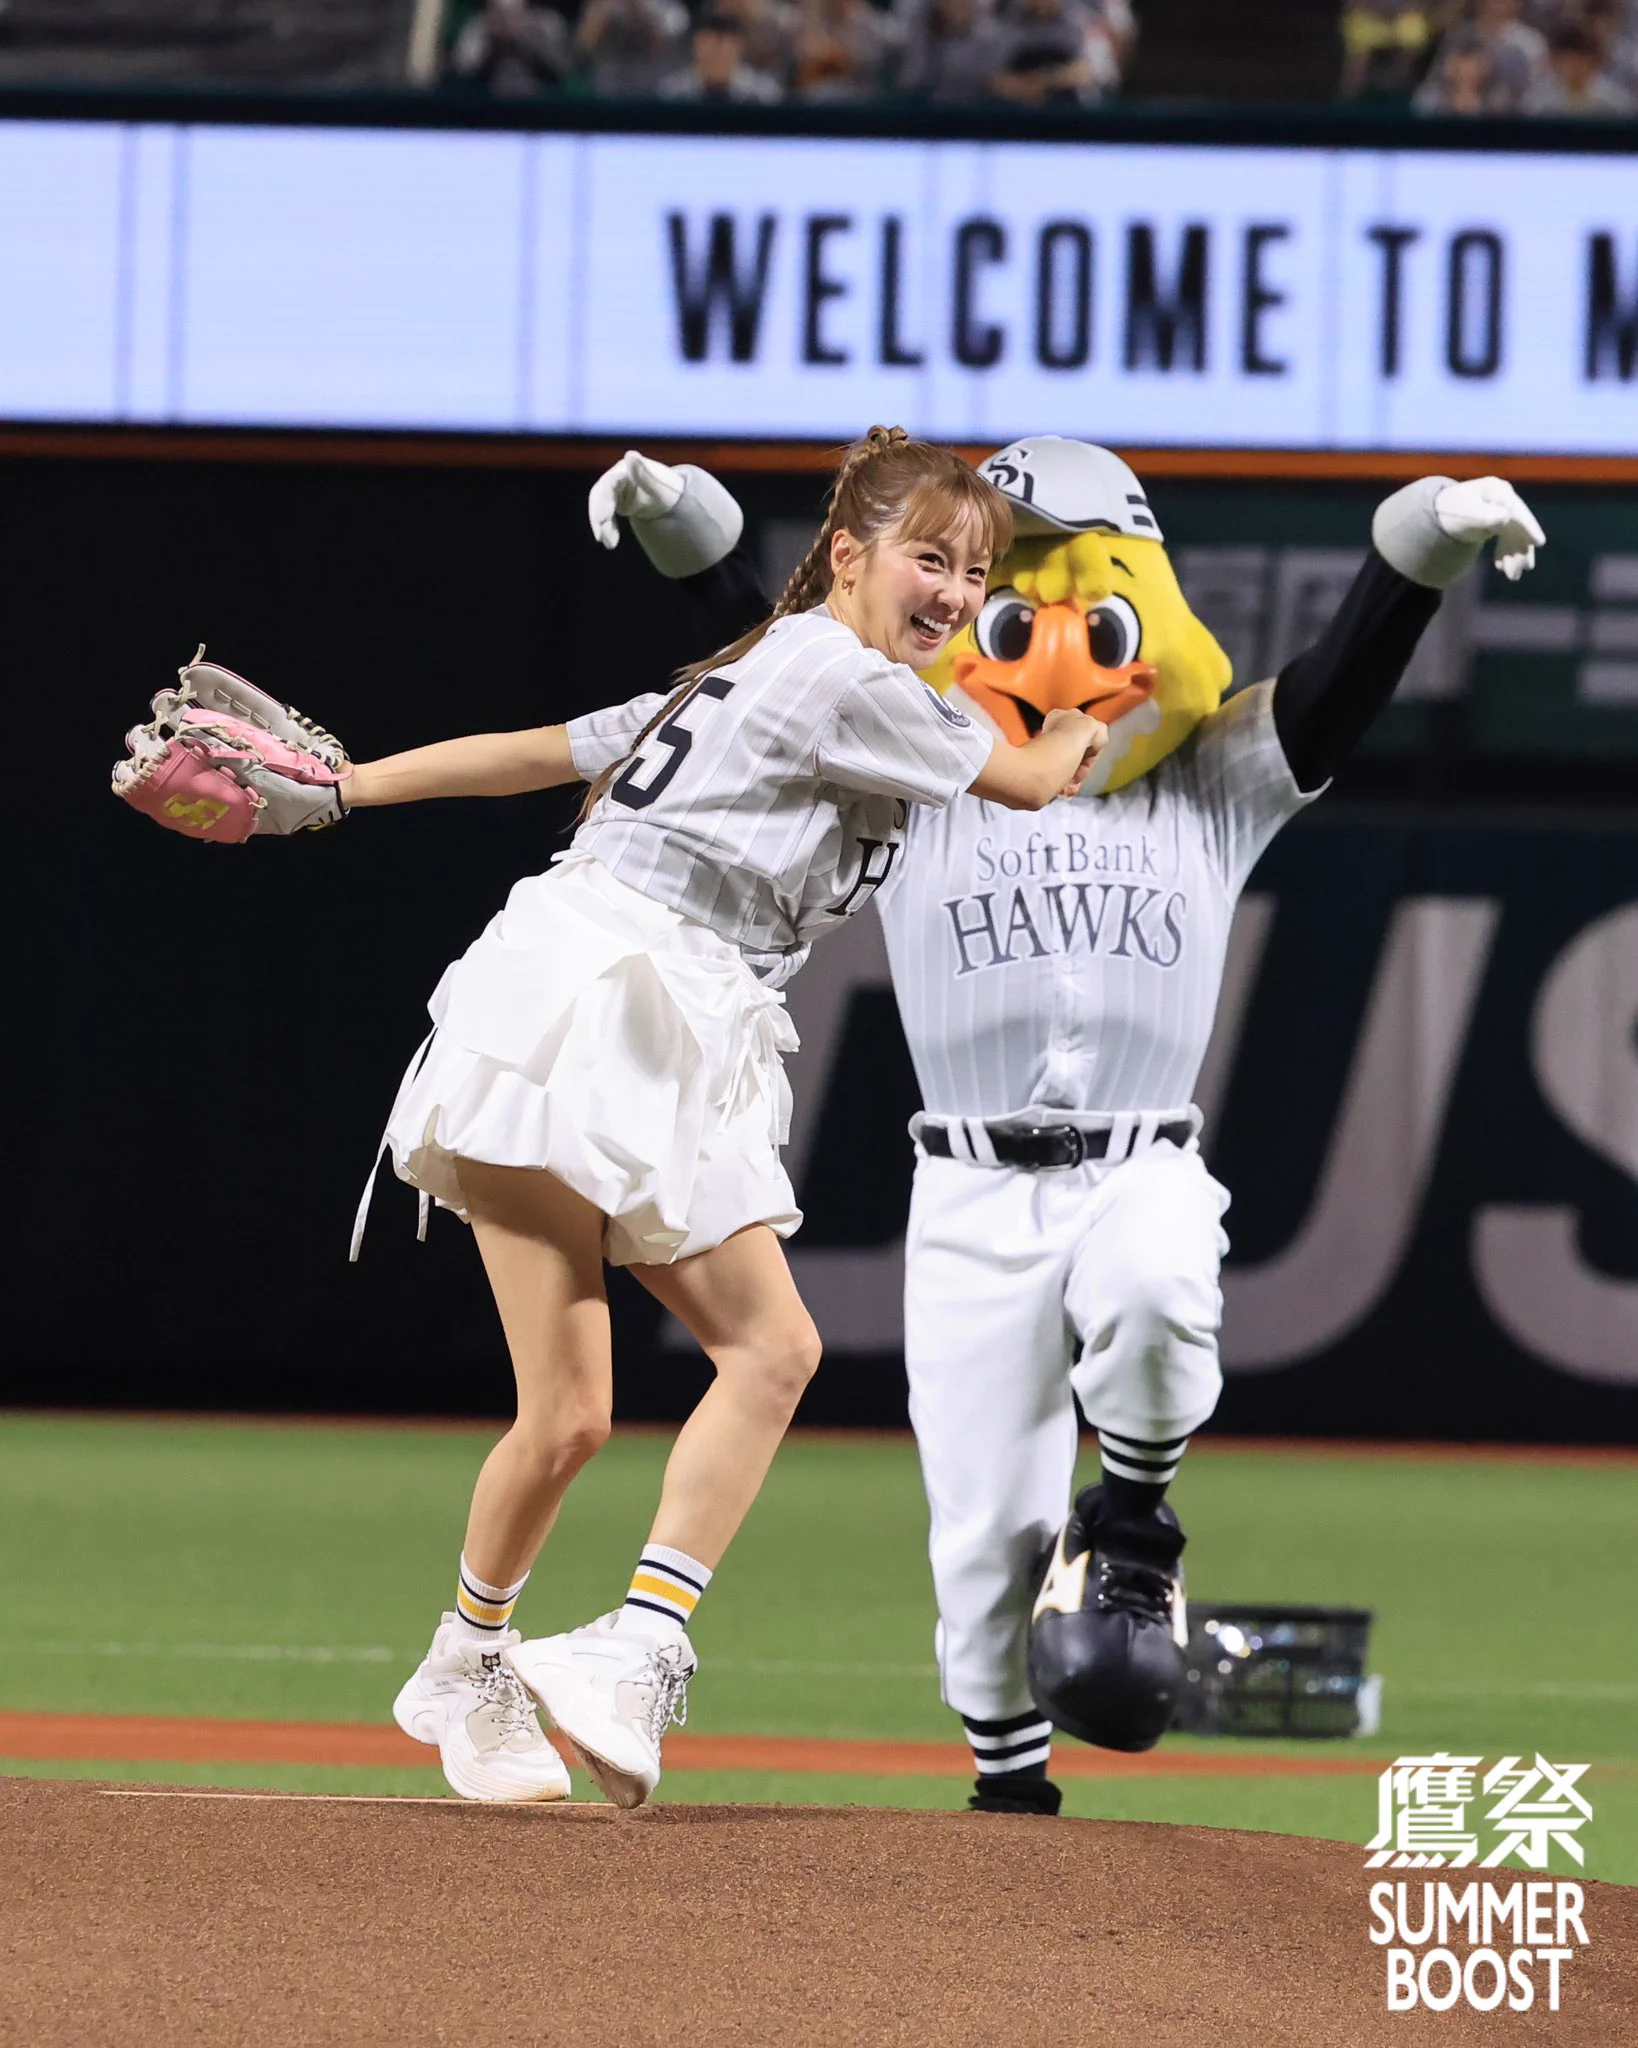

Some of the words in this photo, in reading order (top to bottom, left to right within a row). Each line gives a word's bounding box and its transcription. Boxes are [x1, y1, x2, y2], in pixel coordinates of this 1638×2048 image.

[666, 210, 1293, 377] WELCOME
[1368, 225, 1506, 382] TO
[610, 675, 738, 812] 5
[975, 831, 1159, 883] SoftBank
[942, 883, 1188, 976] HAWKS
